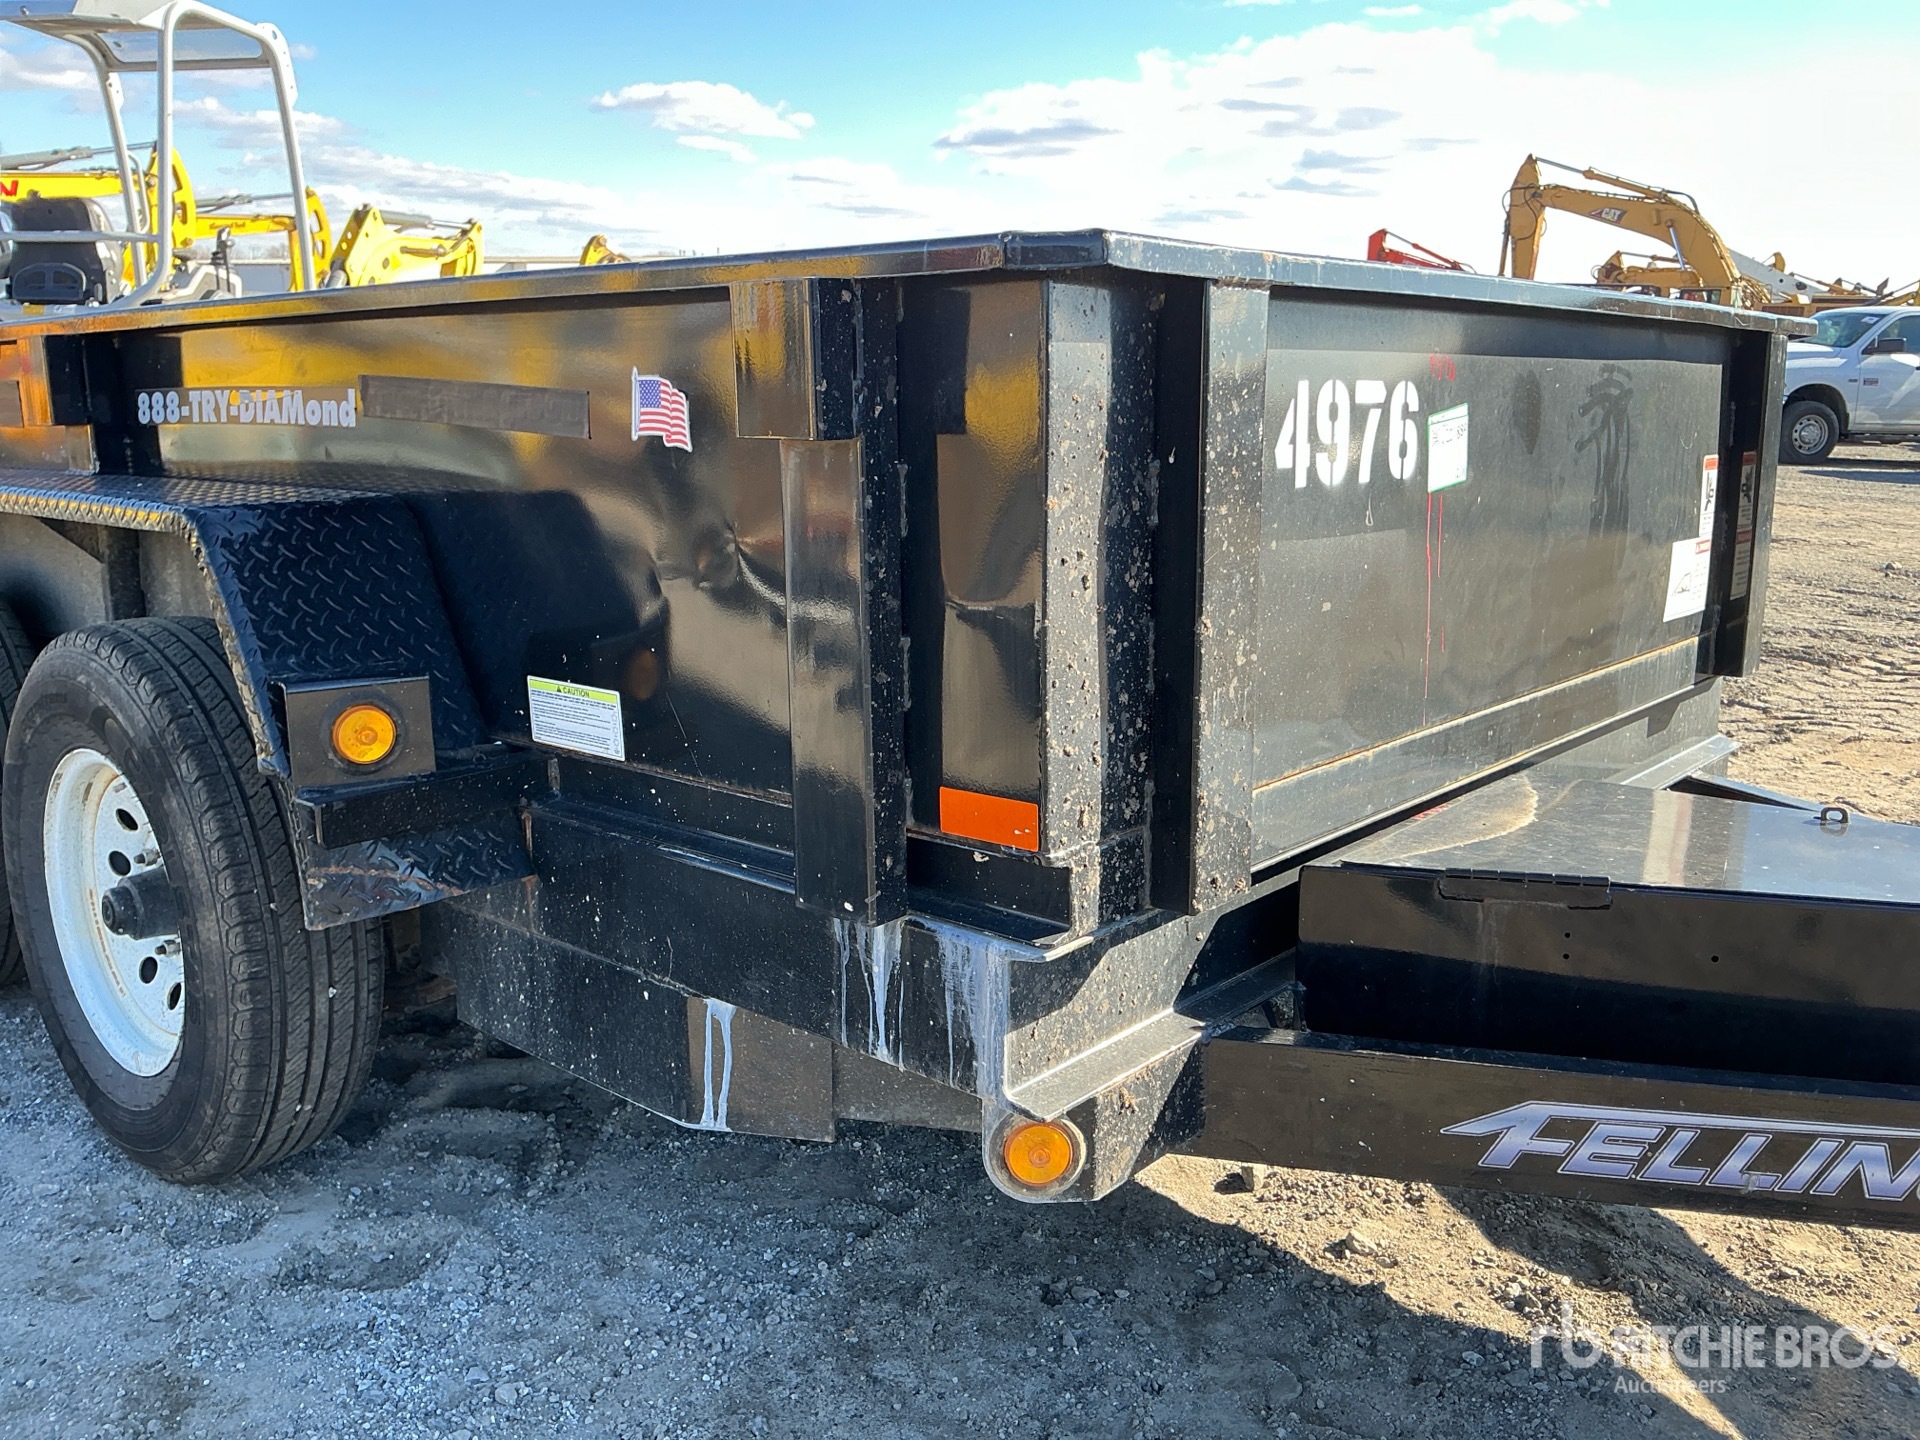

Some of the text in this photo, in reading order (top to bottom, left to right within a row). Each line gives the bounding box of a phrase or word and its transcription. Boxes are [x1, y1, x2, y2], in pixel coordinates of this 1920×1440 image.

[1601, 208, 1622, 221] CAT
[1275, 379, 1419, 489] 4976
[562, 686, 590, 698] CAUTION
[1440, 1100, 1920, 1201] FELLIN
